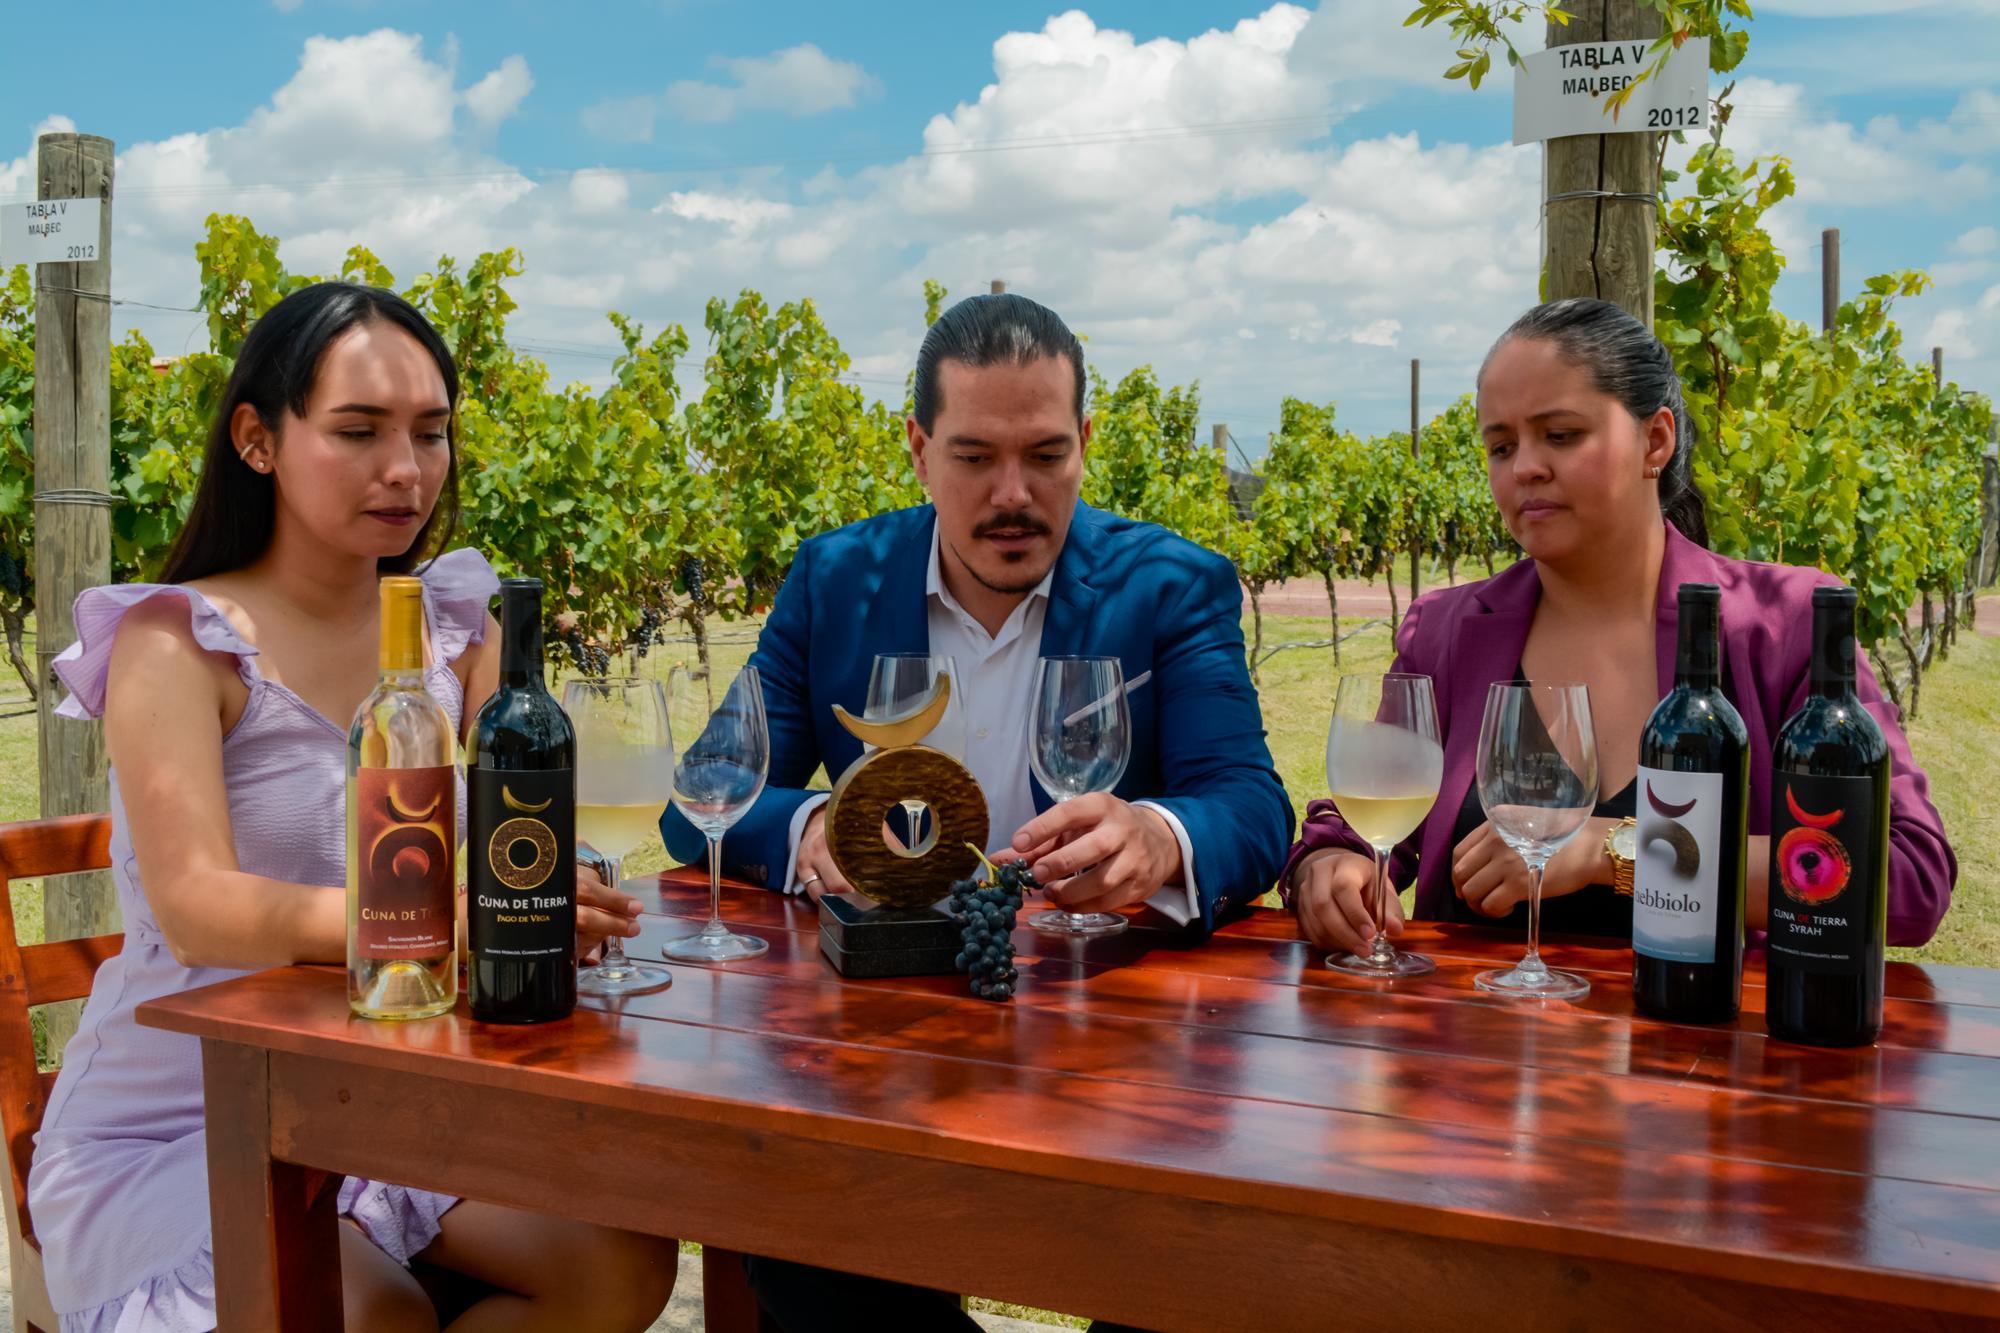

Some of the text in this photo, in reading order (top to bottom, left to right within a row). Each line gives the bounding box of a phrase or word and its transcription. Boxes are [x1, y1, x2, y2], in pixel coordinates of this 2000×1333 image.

[1560, 45, 1645, 68] TABLA V
[1648, 106, 1699, 127] 2012
[26, 202, 67, 218] TABLA V
[28, 222, 61, 235] MALBEC
[68, 245, 94, 258] 2012
[478, 894, 568, 909] CUNA DE TIERRA
[362, 907, 397, 921] CUNA
[401, 910, 417, 921] DE
[497, 914, 517, 923] PAGO
[531, 914, 551, 923] VEGA
[1774, 908, 1795, 921] CUNA
[1813, 915, 1848, 927] TIERRA
[1790, 923, 1822, 936] SYRAH
